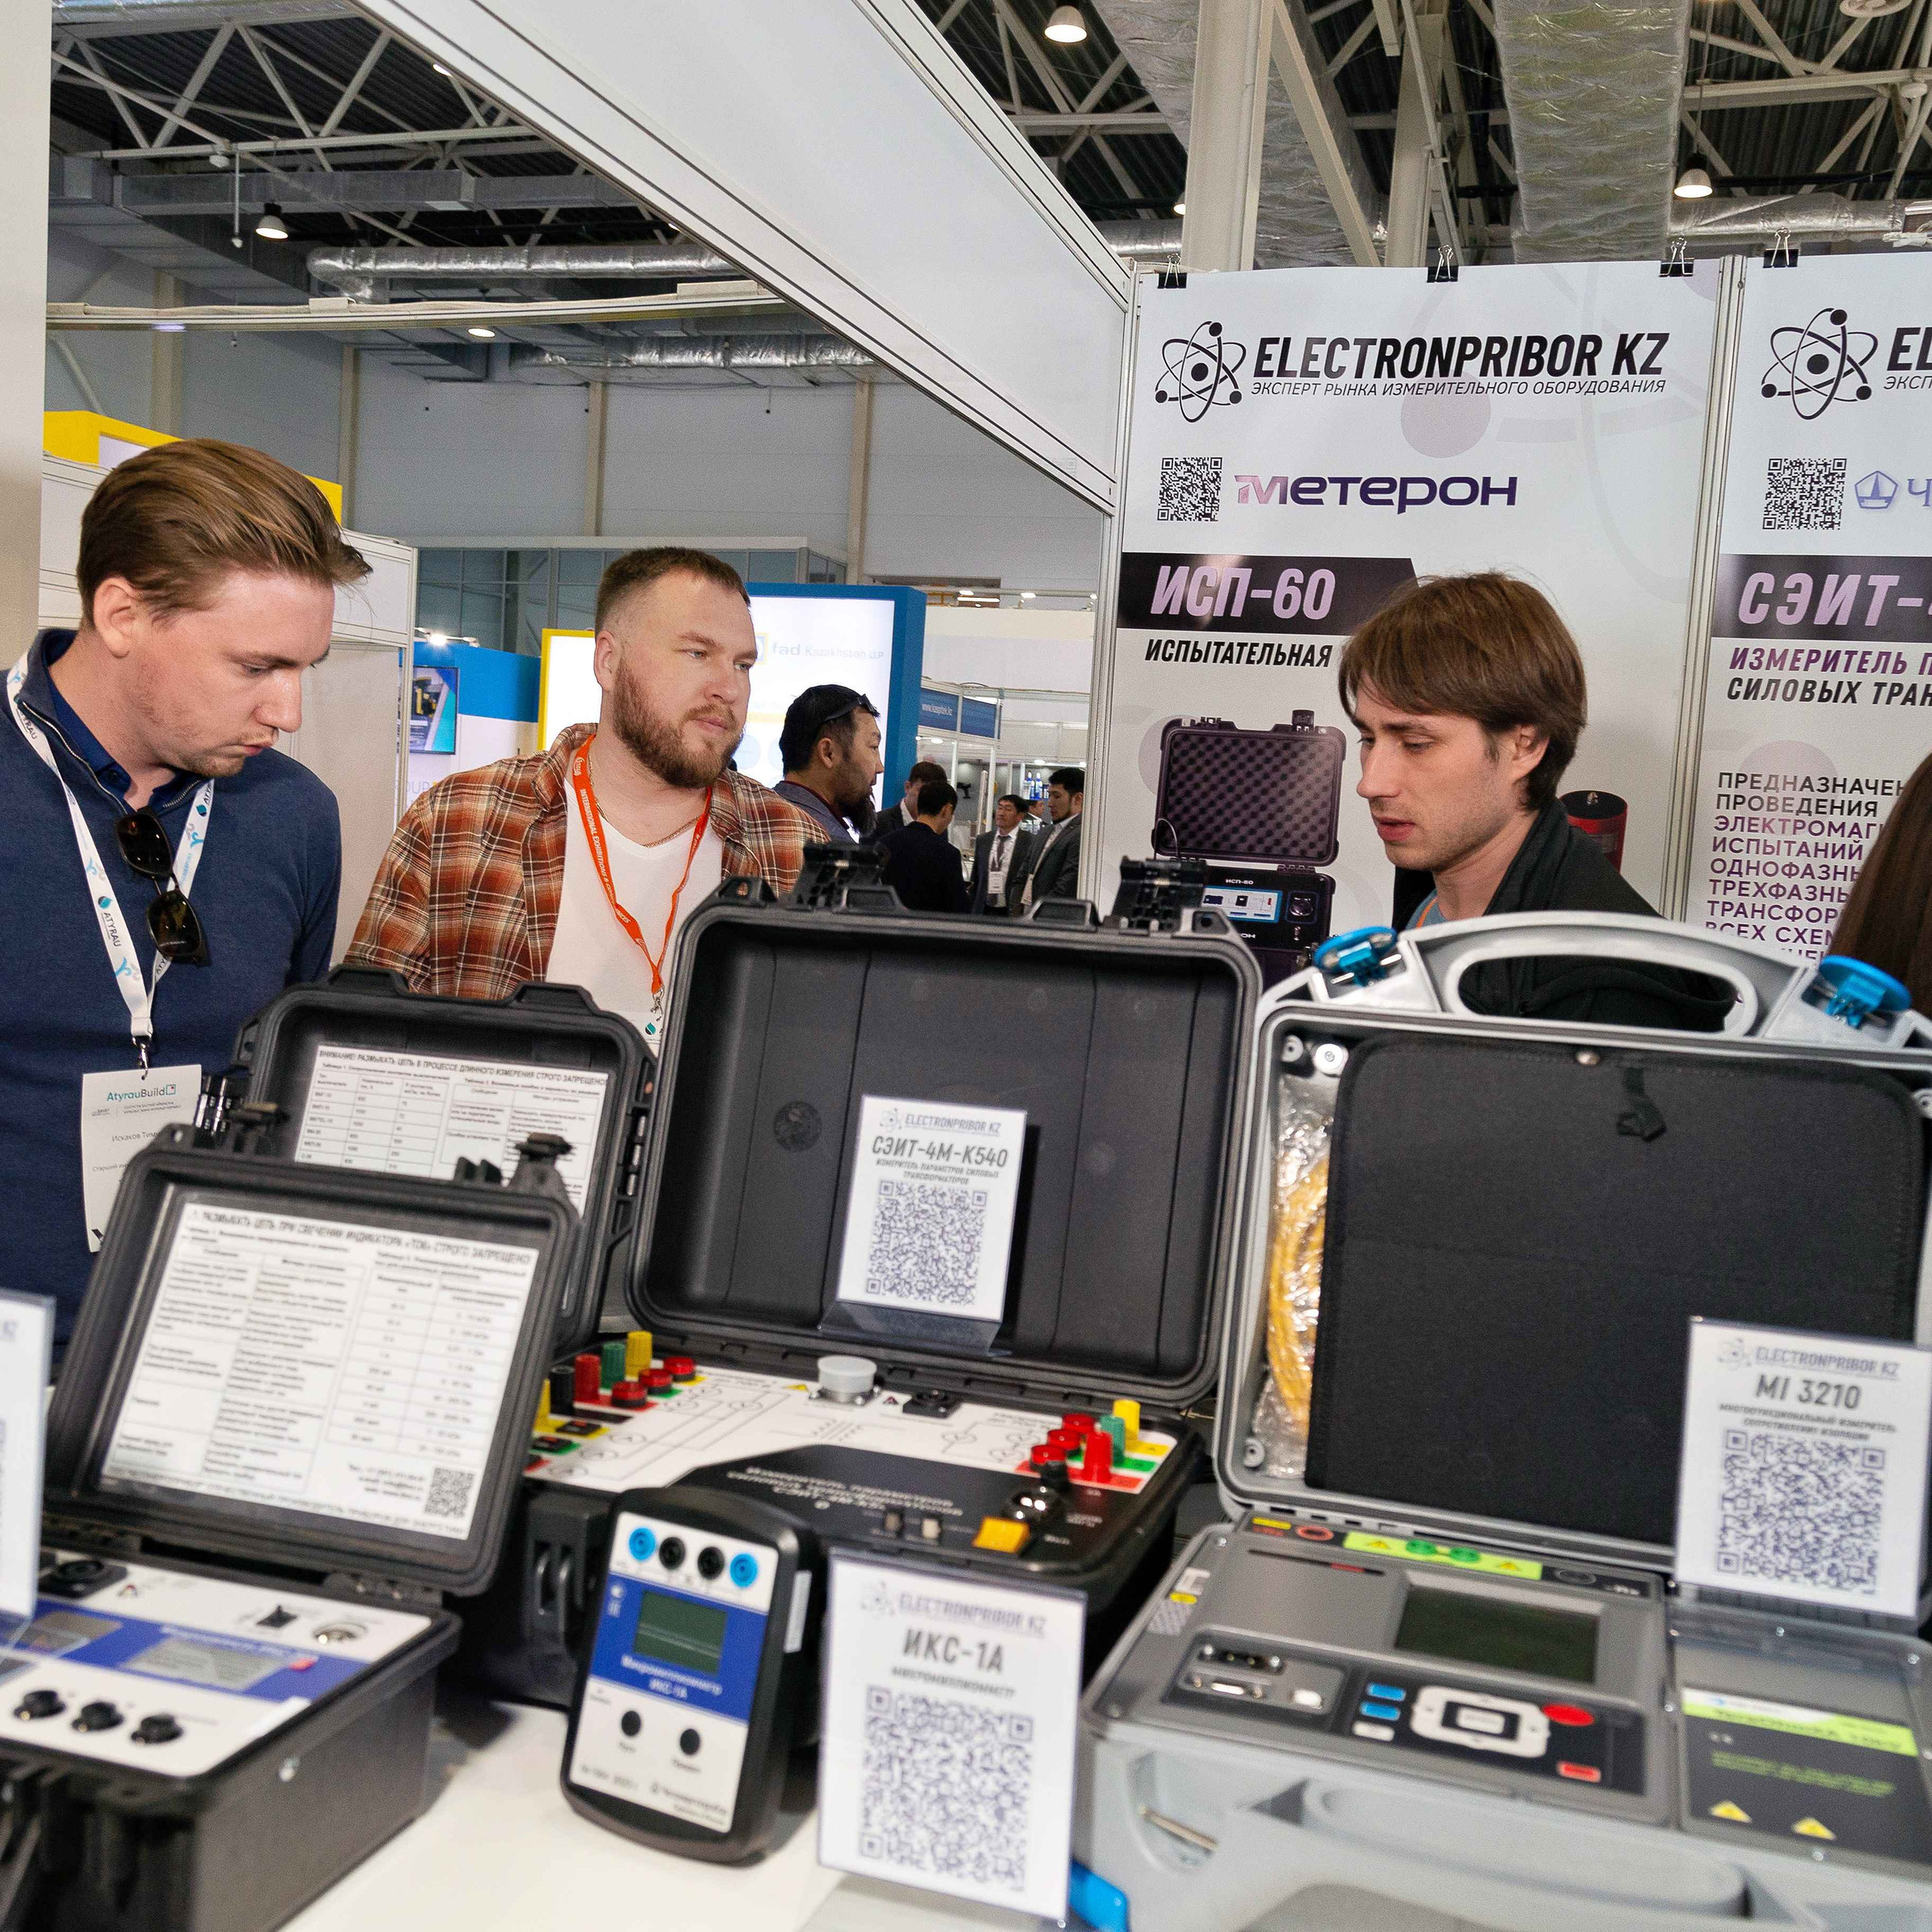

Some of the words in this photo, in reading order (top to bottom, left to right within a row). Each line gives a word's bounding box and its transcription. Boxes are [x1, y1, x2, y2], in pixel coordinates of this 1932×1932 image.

[1253, 334, 1603, 379] ELECTRONPRIBOR
[1611, 332, 1670, 376] KZ
[1251, 382, 1321, 395] ЭКСПЕРТ
[1324, 383, 1377, 396] РЫНКА
[1382, 380, 1528, 396] ИЗМЕРИТЕЛЬНОГО
[1533, 380, 1666, 395] ОБОРУДОВАНИЯ
[1150, 565, 1336, 620] ИСП-60
[1738, 572, 1932, 626] СЭИТ-
[1145, 638, 1334, 668] ИСПЫТАТЕЛЬНАЯ
[1729, 647, 1907, 675] ИЗМЕРИТЕЛЬ
[1727, 677, 1863, 703] СИЛОВЫХ
[1716, 793, 1878, 817] ПРОВЕДЕНИЯ
[580, 788, 596, 836] INTERNATIONAL
[592, 835, 608, 878] EXHIBITIONS
[1713, 815, 1884, 839] ЭЛЕКТРОМАГ
[1712, 836, 1864, 861] ИСПЫТАНИЙ
[103, 912, 122, 948] ATYRAU
[536, 1072, 561, 1081] СТРОГО
[106, 1088, 165, 1102] AtyrauBuild
[905, 1113, 987, 1131] ELECTRONPRIBOR
[989, 1121, 1002, 1134] KZ
[1755, 1346, 1876, 1371] ELECTRONPRIBOR
[1755, 1374, 1791, 1401] MI
[1797, 1377, 1863, 1410] 3210
[903, 1629, 1004, 1674] ИКС-1А
